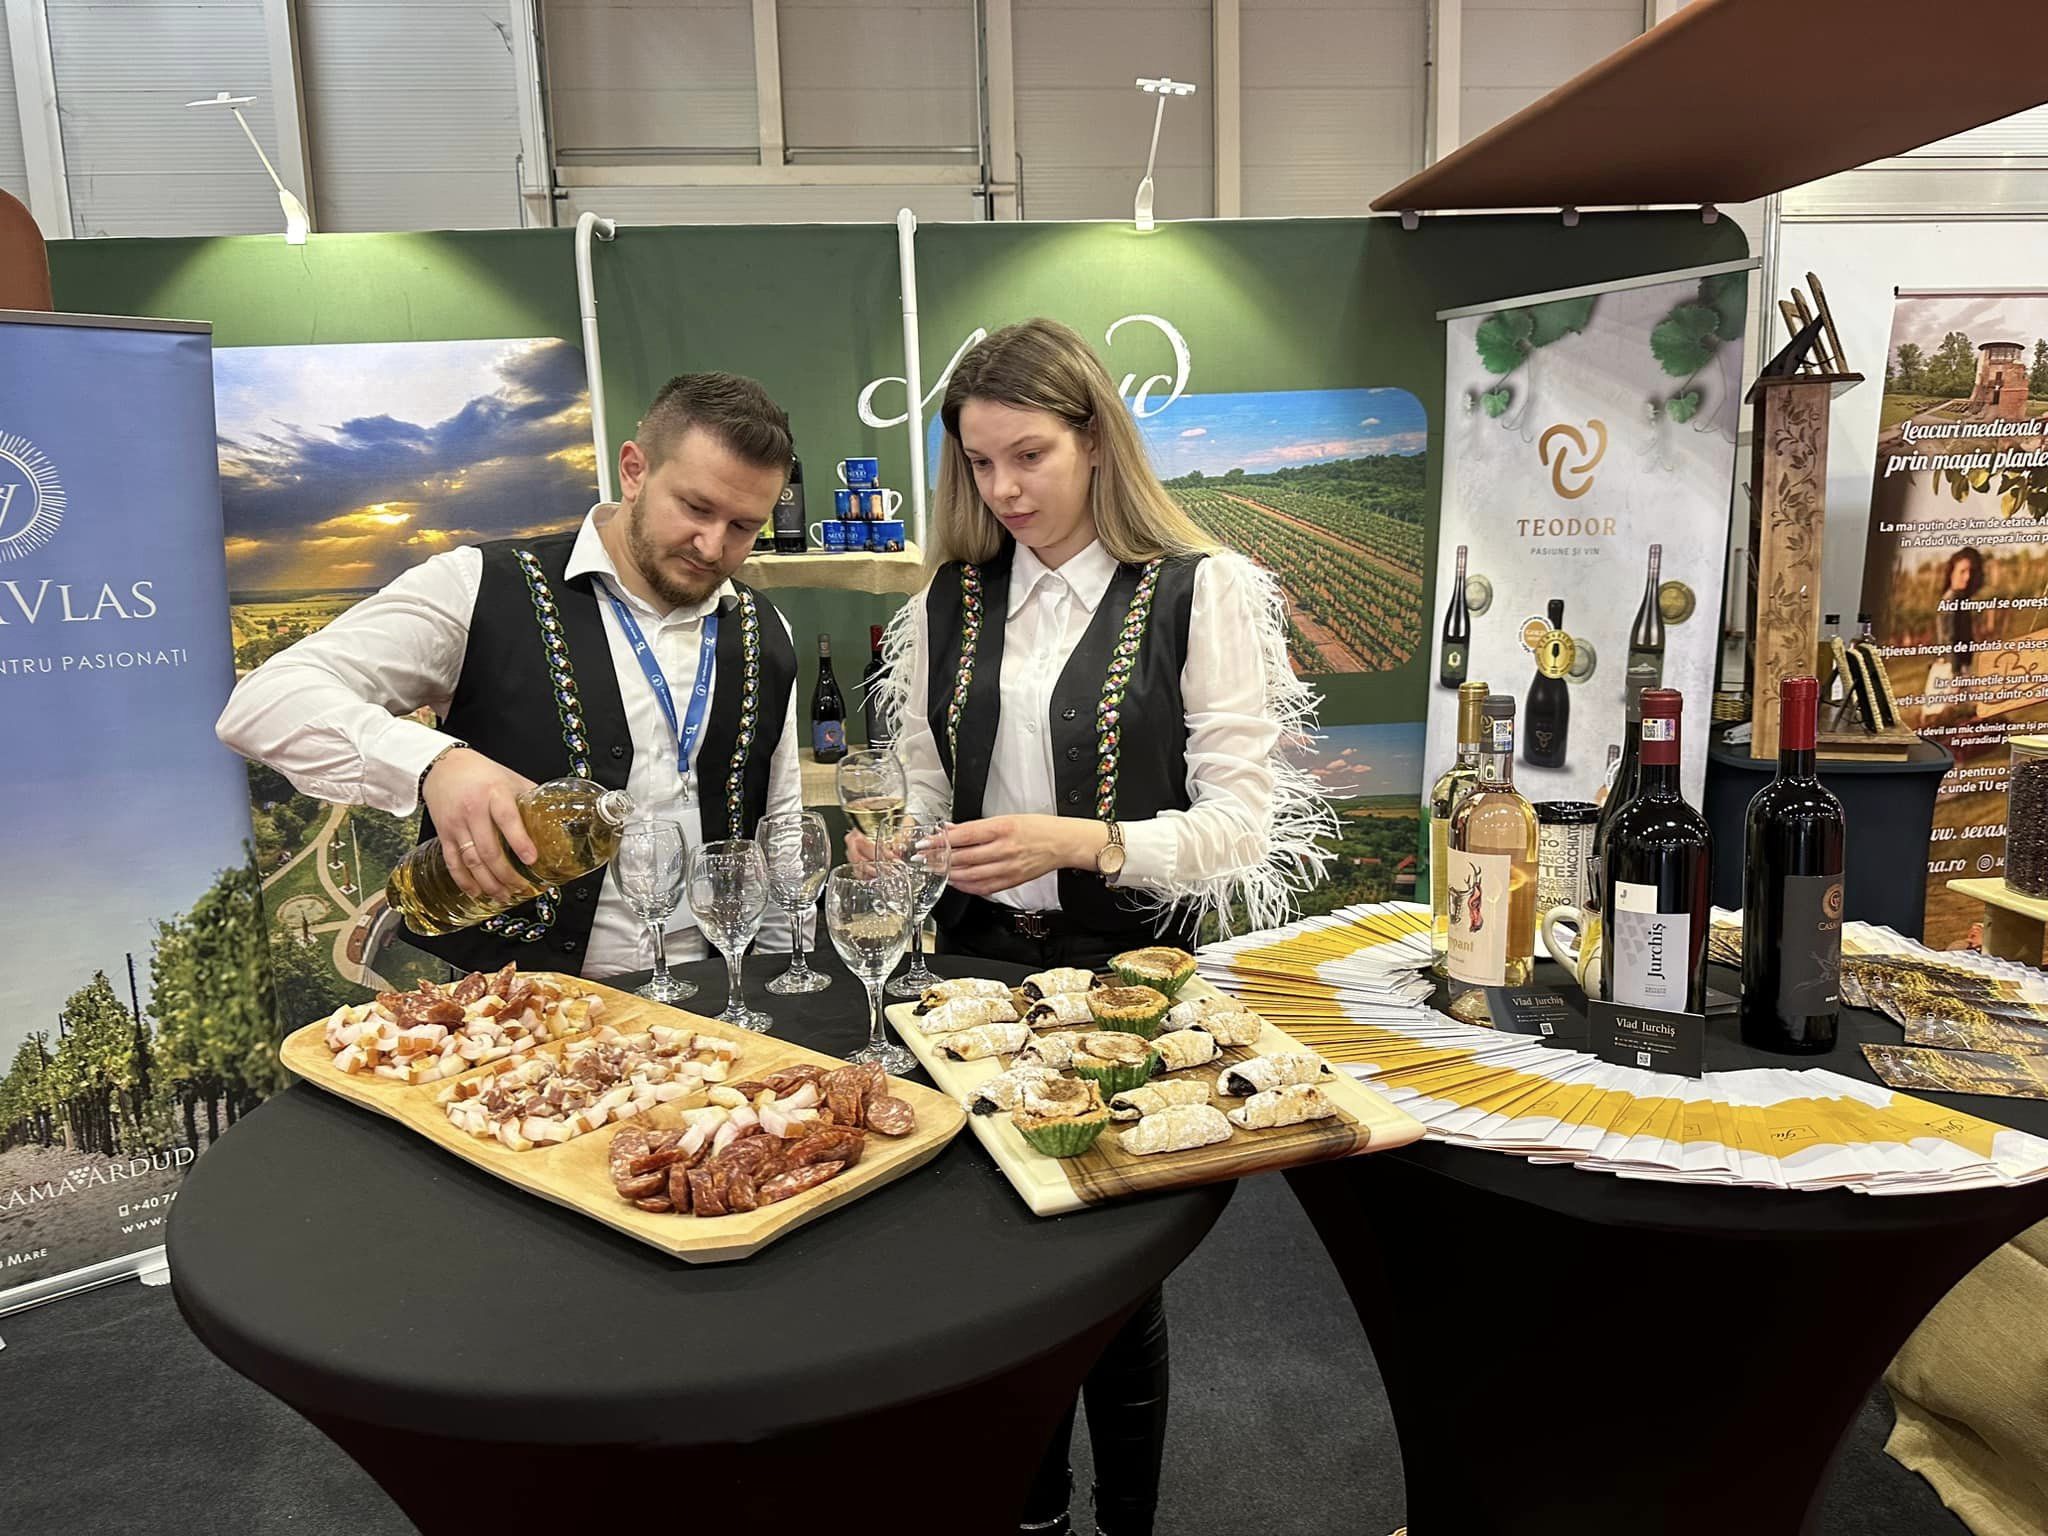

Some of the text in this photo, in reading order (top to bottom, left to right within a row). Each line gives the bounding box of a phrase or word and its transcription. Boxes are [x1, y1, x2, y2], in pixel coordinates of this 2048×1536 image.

[1901, 419, 1961, 445] Leacuri
[1961, 417, 2042, 437] medievale
[1883, 449, 1929, 478] prin
[1930, 448, 1992, 476] magia
[1517, 518, 1616, 537] TEODOR
[1879, 521, 1894, 532] La
[1895, 520, 1917, 531] mai
[1946, 518, 1959, 530] de
[1960, 519, 1967, 529] 3
[1969, 518, 1985, 528] km
[1987, 517, 2000, 528] de
[2001, 518, 2037, 528] cetatea
[1913, 535, 1944, 547] Ardud
[1962, 535, 1974, 545] se
[1584, 547, 1600, 555] VIN
[0, 579, 157, 625] VLAS
[1937, 599, 1958, 612] Aici
[1960, 598, 1997, 613] timpul
[1997, 599, 2010, 609] se
[1953, 641, 1967, 653] de
[2003, 642, 2016, 651] ce
[2005, 673, 2030, 684] sunt
[1996, 687, 2033, 700] dintr-o
[1945, 726, 1957, 735] un
[1958, 724, 1974, 734] mic
[1974, 722, 2006, 733] chimist
[2006, 722, 2026, 731] care
[1960, 734, 2001, 748] paradisul
[1960, 766, 1996, 780] pentru
[1948, 782, 1977, 794] unde
[1978, 780, 1994, 792] TU
[1511, 996, 1533, 1006] Vlad
[1615, 1017, 1638, 1030] Vlad
[88, 1146, 195, 1189] ARDUD
